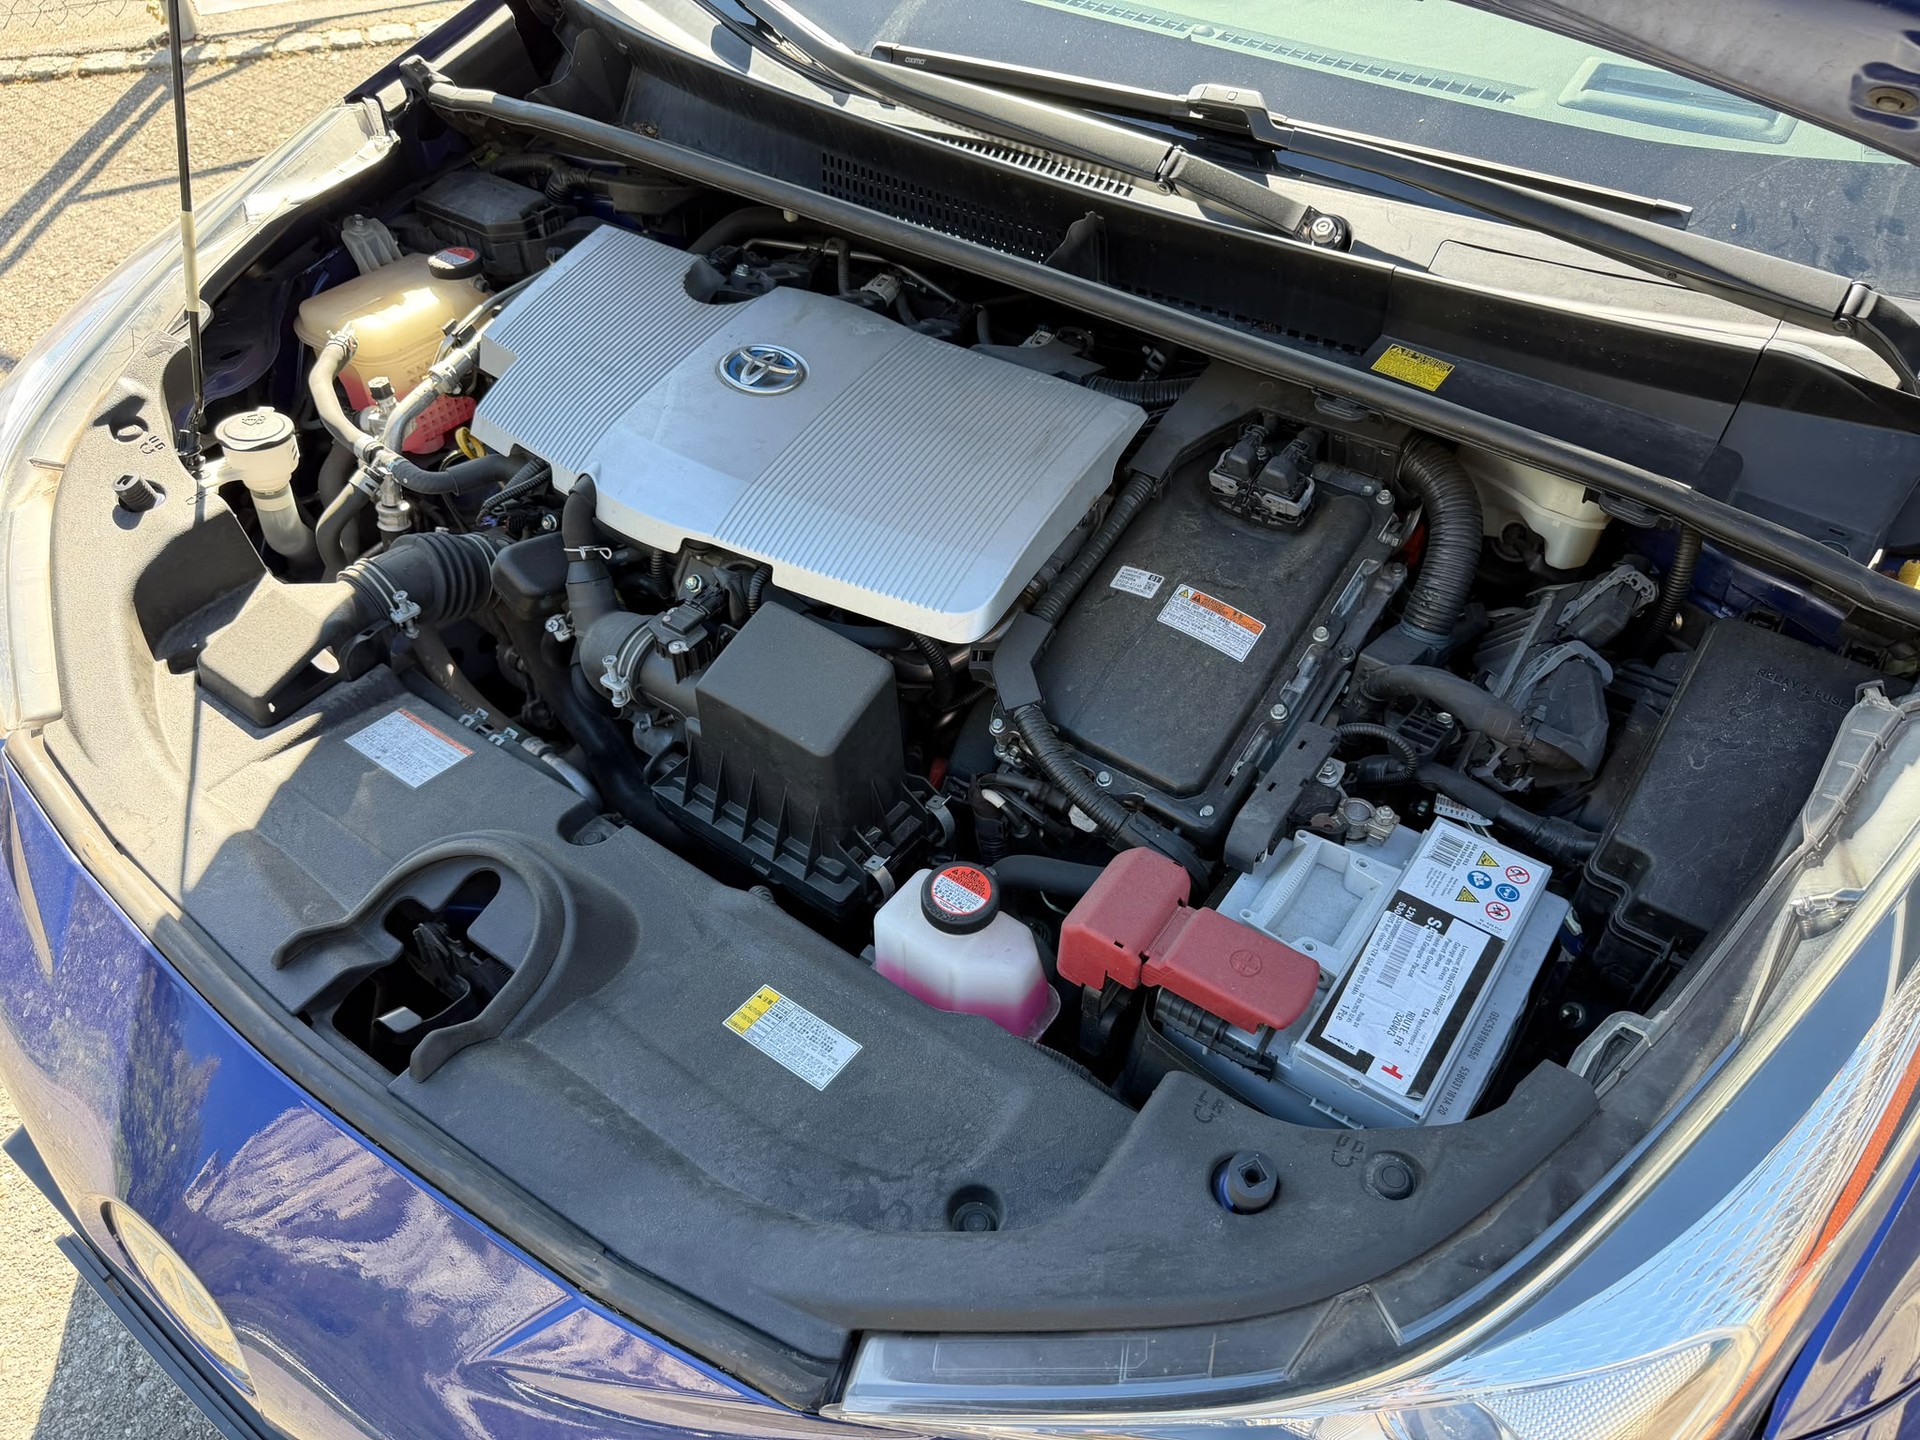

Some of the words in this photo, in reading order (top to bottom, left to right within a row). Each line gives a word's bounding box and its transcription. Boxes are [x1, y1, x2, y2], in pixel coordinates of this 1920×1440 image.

[1756, 668, 1799, 689] RELAY
[1403, 905, 1417, 920] 12V
[1398, 1010, 1416, 1036] ROUTE:
